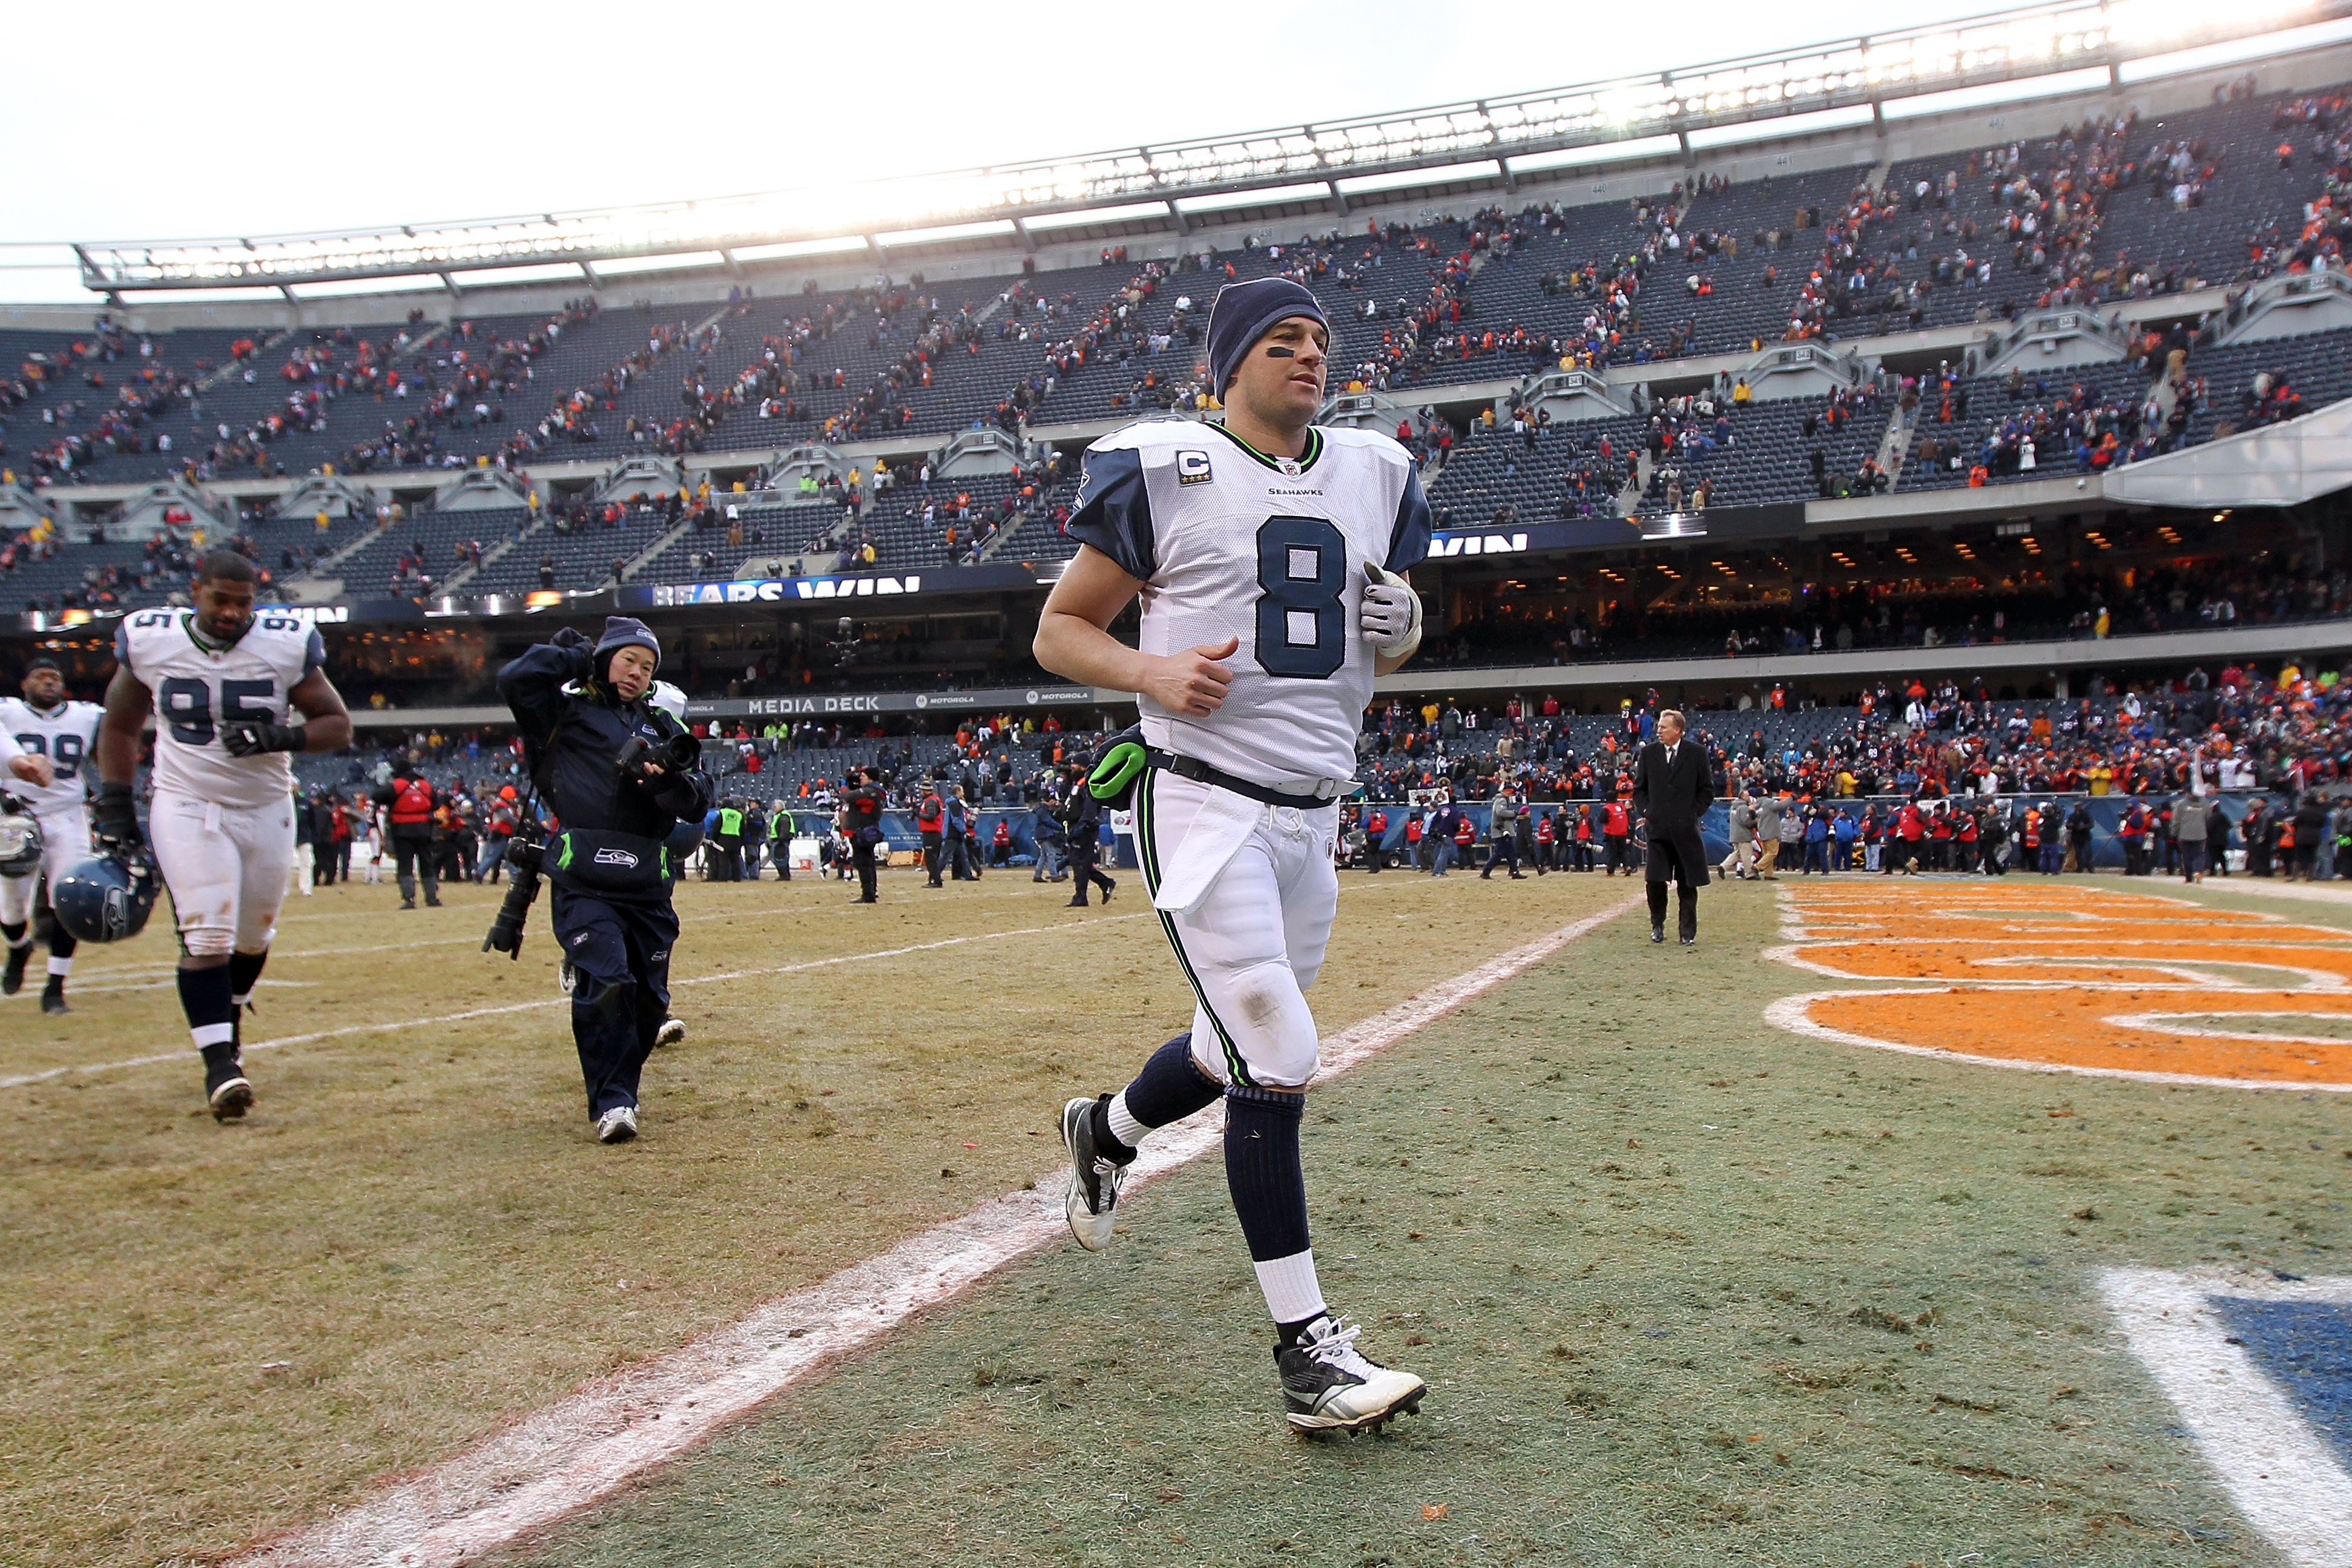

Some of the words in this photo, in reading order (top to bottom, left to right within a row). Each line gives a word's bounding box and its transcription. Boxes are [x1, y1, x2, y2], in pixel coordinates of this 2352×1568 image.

[1592, 183, 1607, 193] 440
[1569, 376, 1582, 386] 341
[1179, 451, 1210, 477] C
[796, 576, 920, 599] WIN
[1255, 515, 1346, 679] 8
[162, 677, 274, 745] 95
[748, 700, 815, 714] MEDIA
[825, 696, 880, 711] DECK
[1621, 710, 1630, 719] 23
